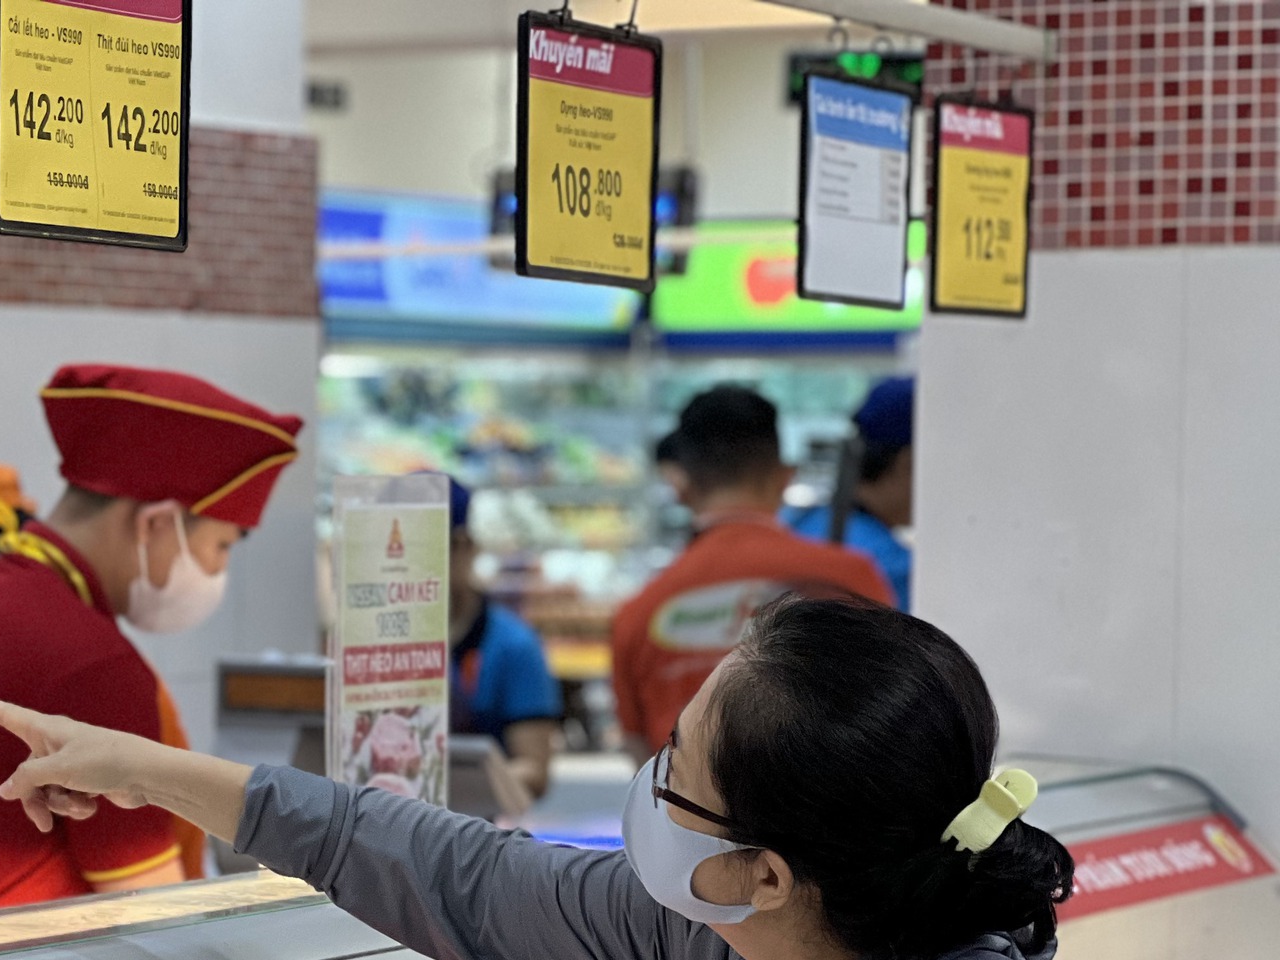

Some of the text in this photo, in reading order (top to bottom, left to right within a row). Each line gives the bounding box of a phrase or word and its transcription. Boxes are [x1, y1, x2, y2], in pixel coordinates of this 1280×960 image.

[35, 22, 49, 40] heo
[57, 26, 82, 46] VS990
[97, 33, 114, 54] Thịt
[132, 39, 149, 56] heo
[151, 42, 180, 60] VS990
[529, 28, 583, 74] Khuyến
